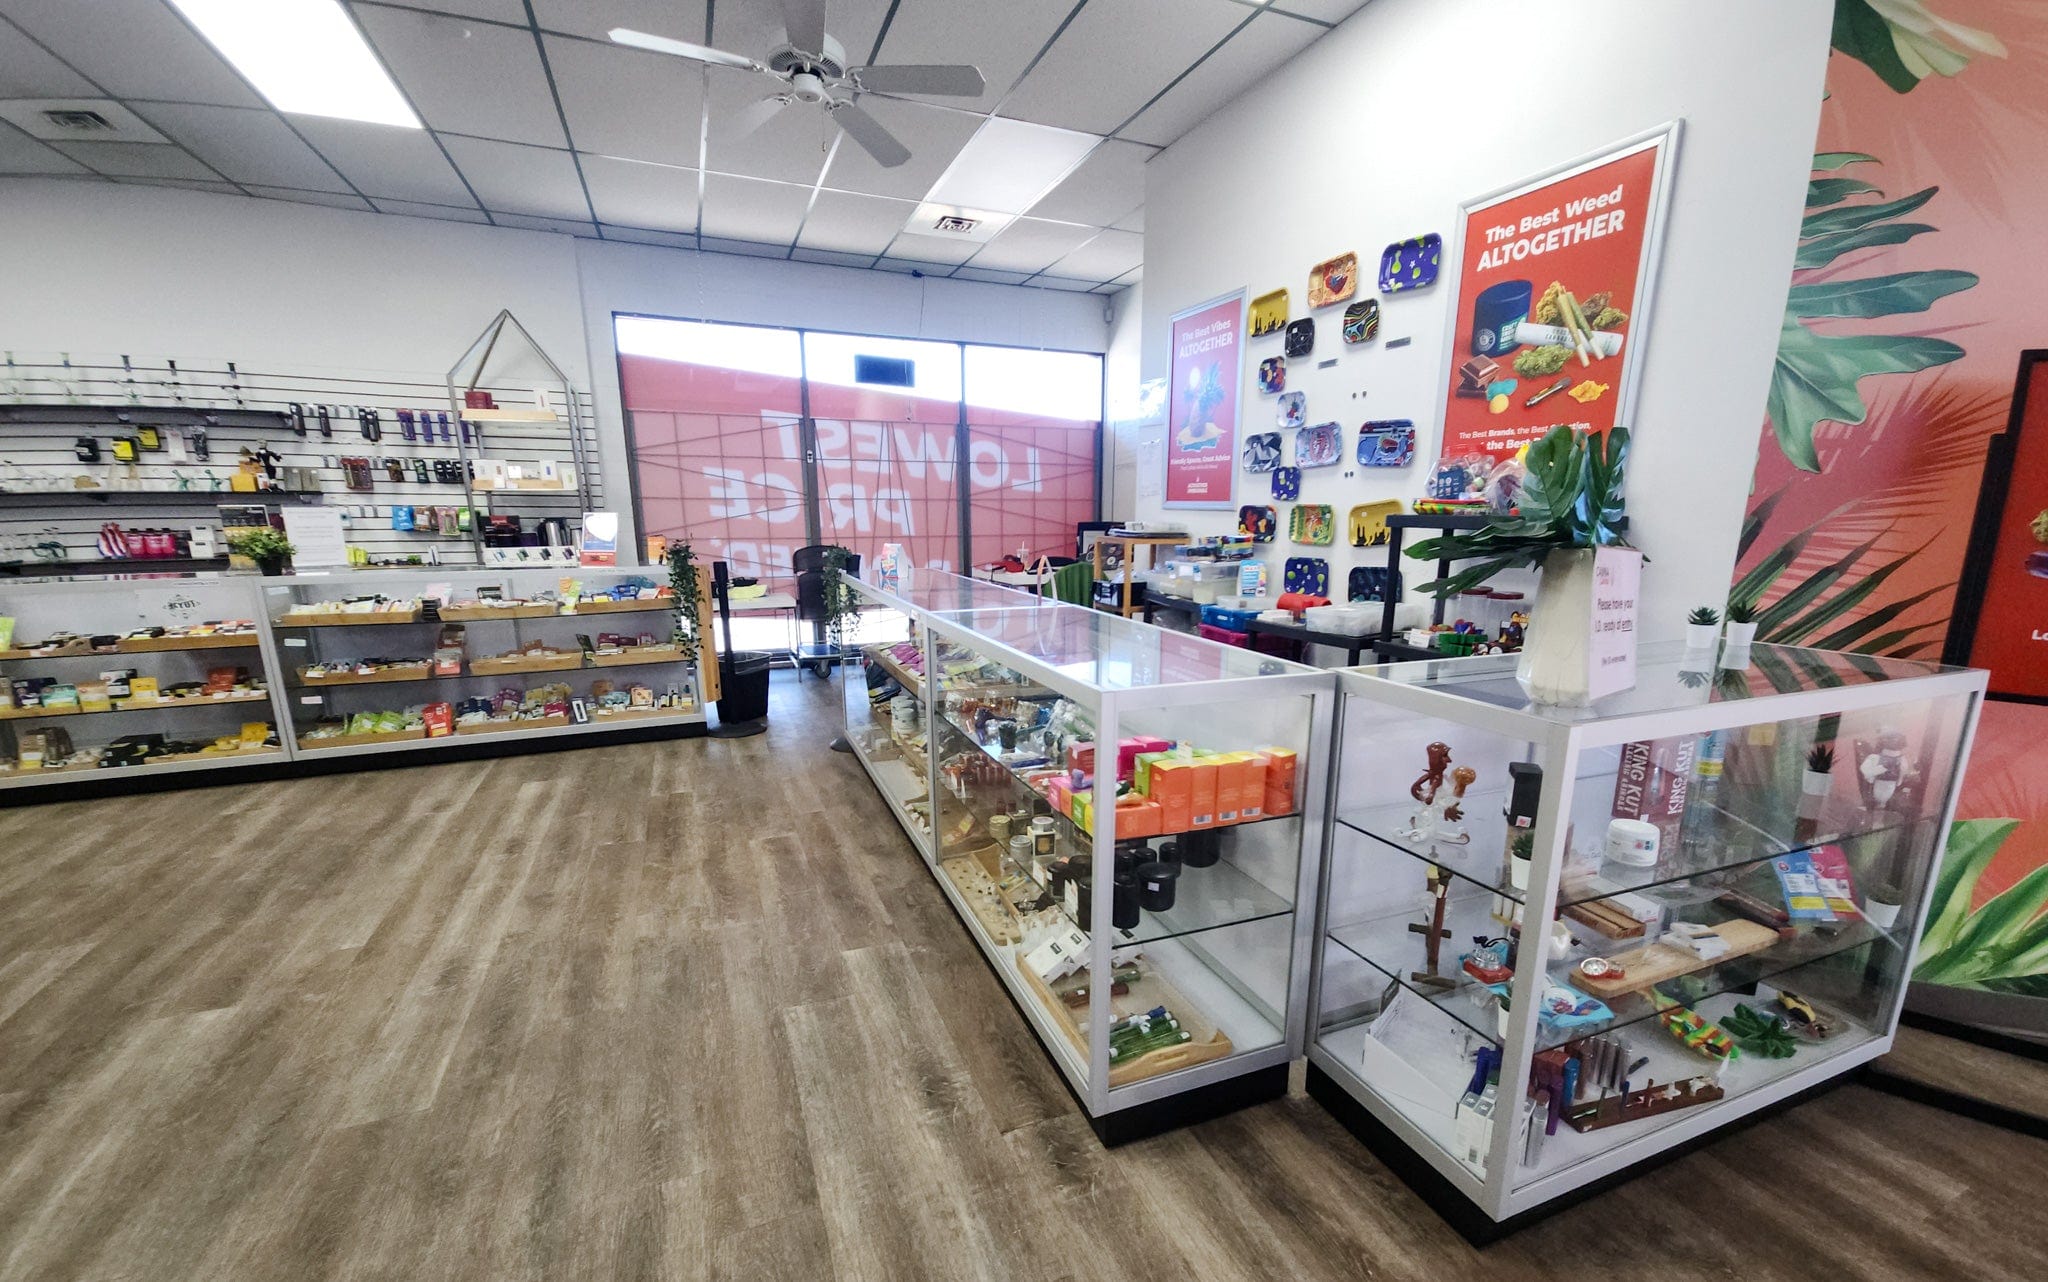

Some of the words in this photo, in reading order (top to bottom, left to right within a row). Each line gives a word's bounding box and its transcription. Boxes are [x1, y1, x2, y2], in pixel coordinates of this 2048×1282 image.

[1485, 225, 1516, 244] The
[1519, 207, 1560, 234] Best
[1565, 184, 1624, 218] Weed
[1476, 209, 1626, 272] ALTOGETHER
[1179, 331, 1233, 359] ALTOGETHER
[1182, 332, 1194, 342] The
[1194, 325, 1210, 338] Best
[1210, 319, 1232, 333] Vibes
[1486, 440, 1505, 450] the
[1629, 742, 1650, 782] KING
[1623, 783, 1643, 817] KUT
[1667, 776, 1684, 815] KING
